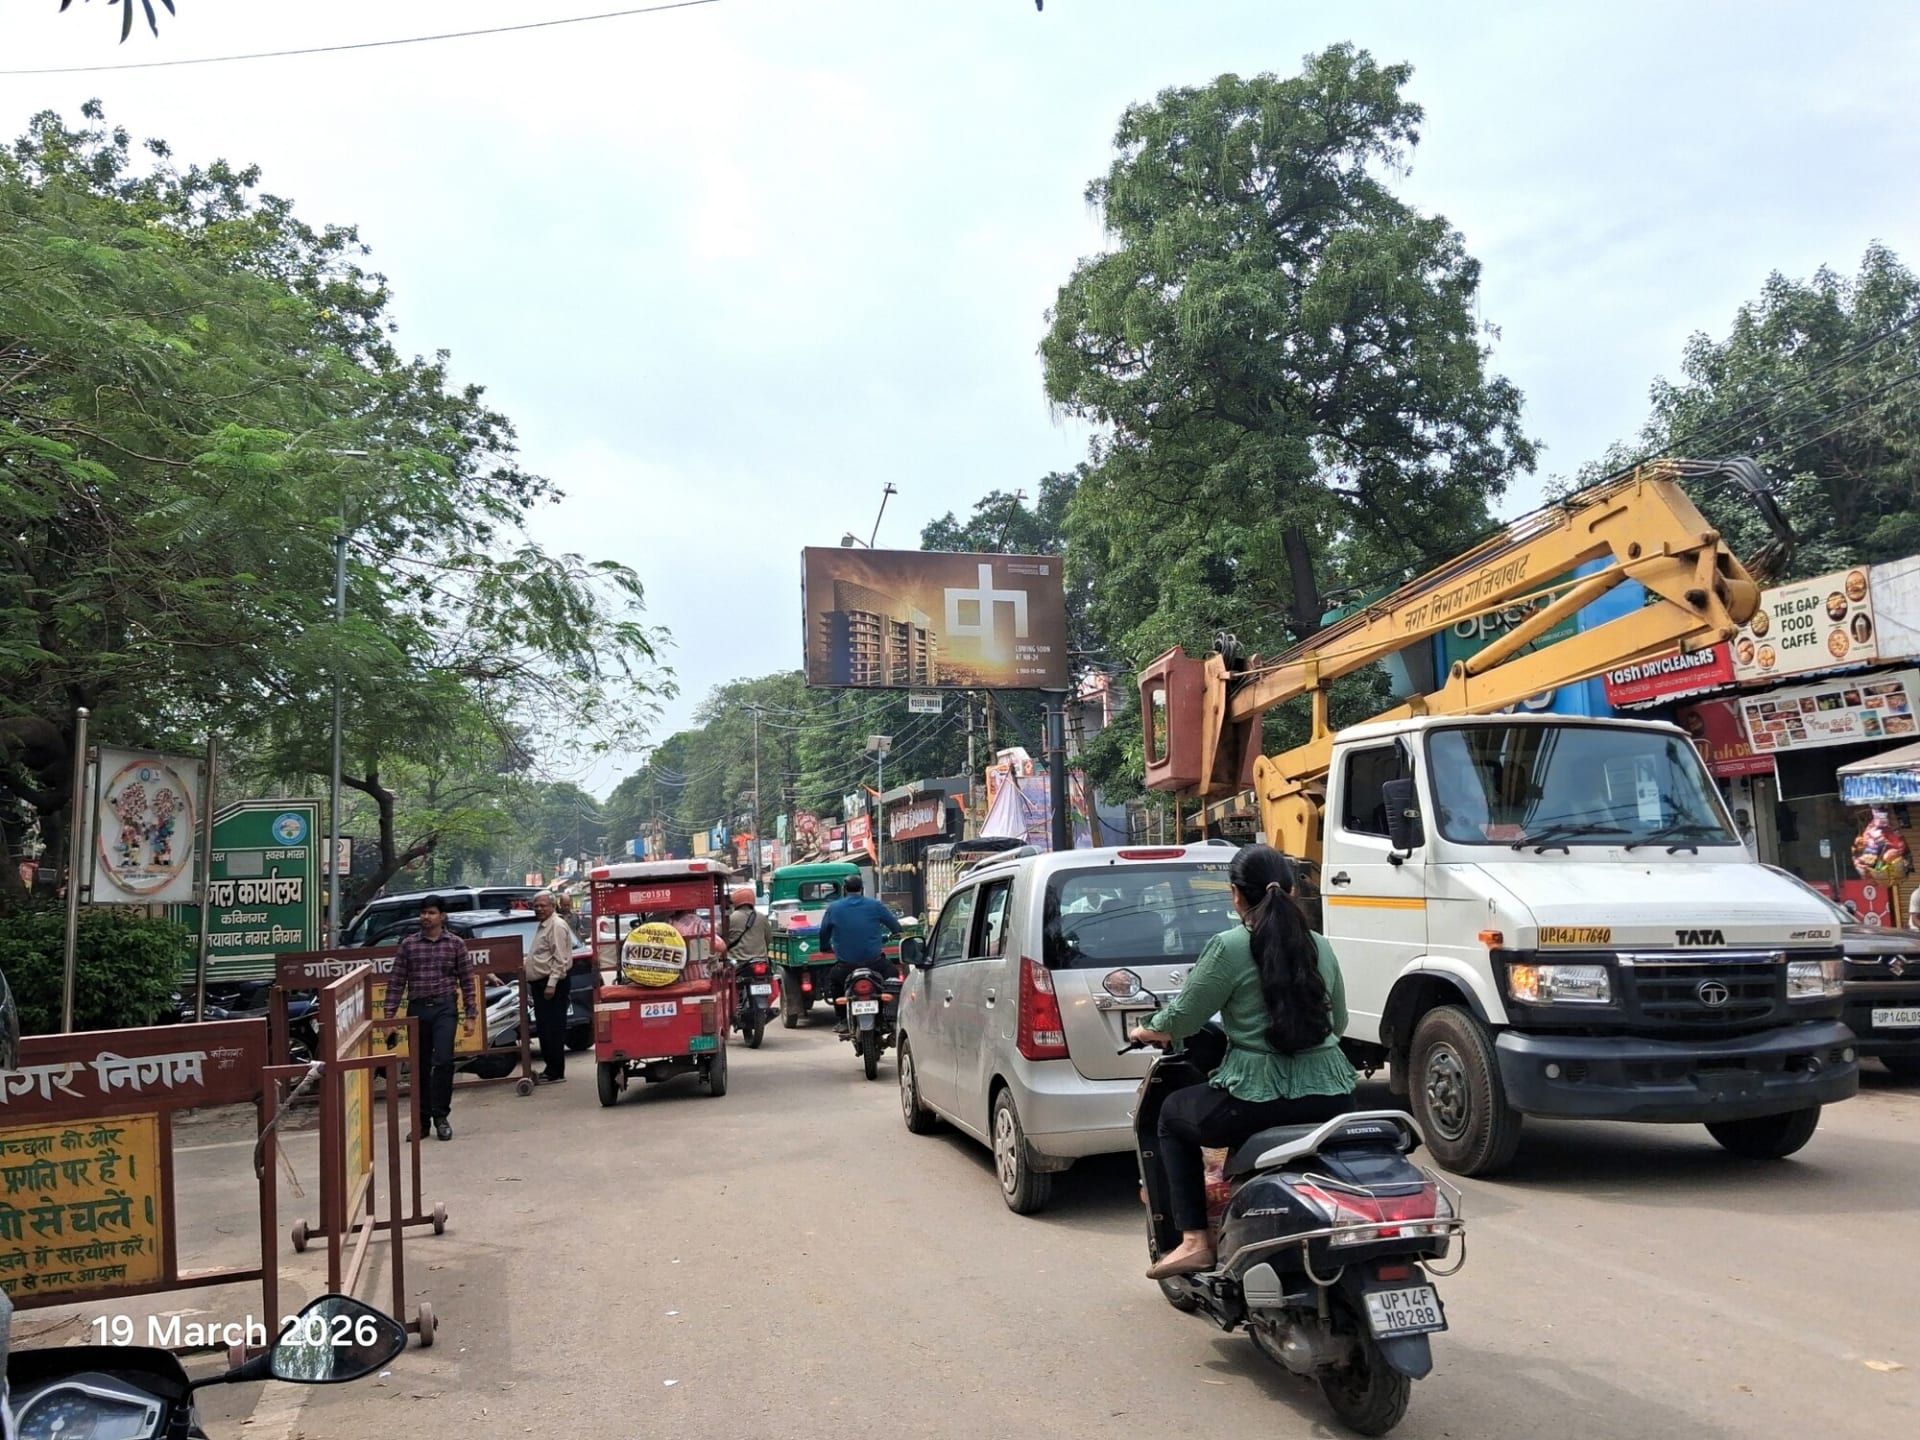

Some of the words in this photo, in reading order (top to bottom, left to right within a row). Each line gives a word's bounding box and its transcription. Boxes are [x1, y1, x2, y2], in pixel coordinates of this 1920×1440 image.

[1774, 600, 1794, 617] THE
[1796, 596, 1820, 611] GAP
[1781, 615, 1814, 632] FOOD
[1781, 628, 1818, 649] CAFFÉ
[1606, 666, 1641, 685] Yash
[1642, 648, 1715, 678] DRYCLEANERS
[237, 867, 303, 905] कार्यालय
[220, 909, 268, 925] कविनगर
[244, 930, 270, 946] नगर
[271, 924, 302, 945] निगम
[1675, 929, 1725, 946] TATA
[626, 945, 682, 964] KIDZEE
[645, 1004, 674, 1016] 2814
[88, 1051, 208, 1095] निगम
[59, 1158, 95, 1187] पर
[67, 1189, 133, 1233] चलें
[56, 1238, 117, 1267] सहयोग
[117, 1233, 146, 1257] करें
[41, 1271, 75, 1287] नगर
[1380, 1288, 1429, 1310] UP14F
